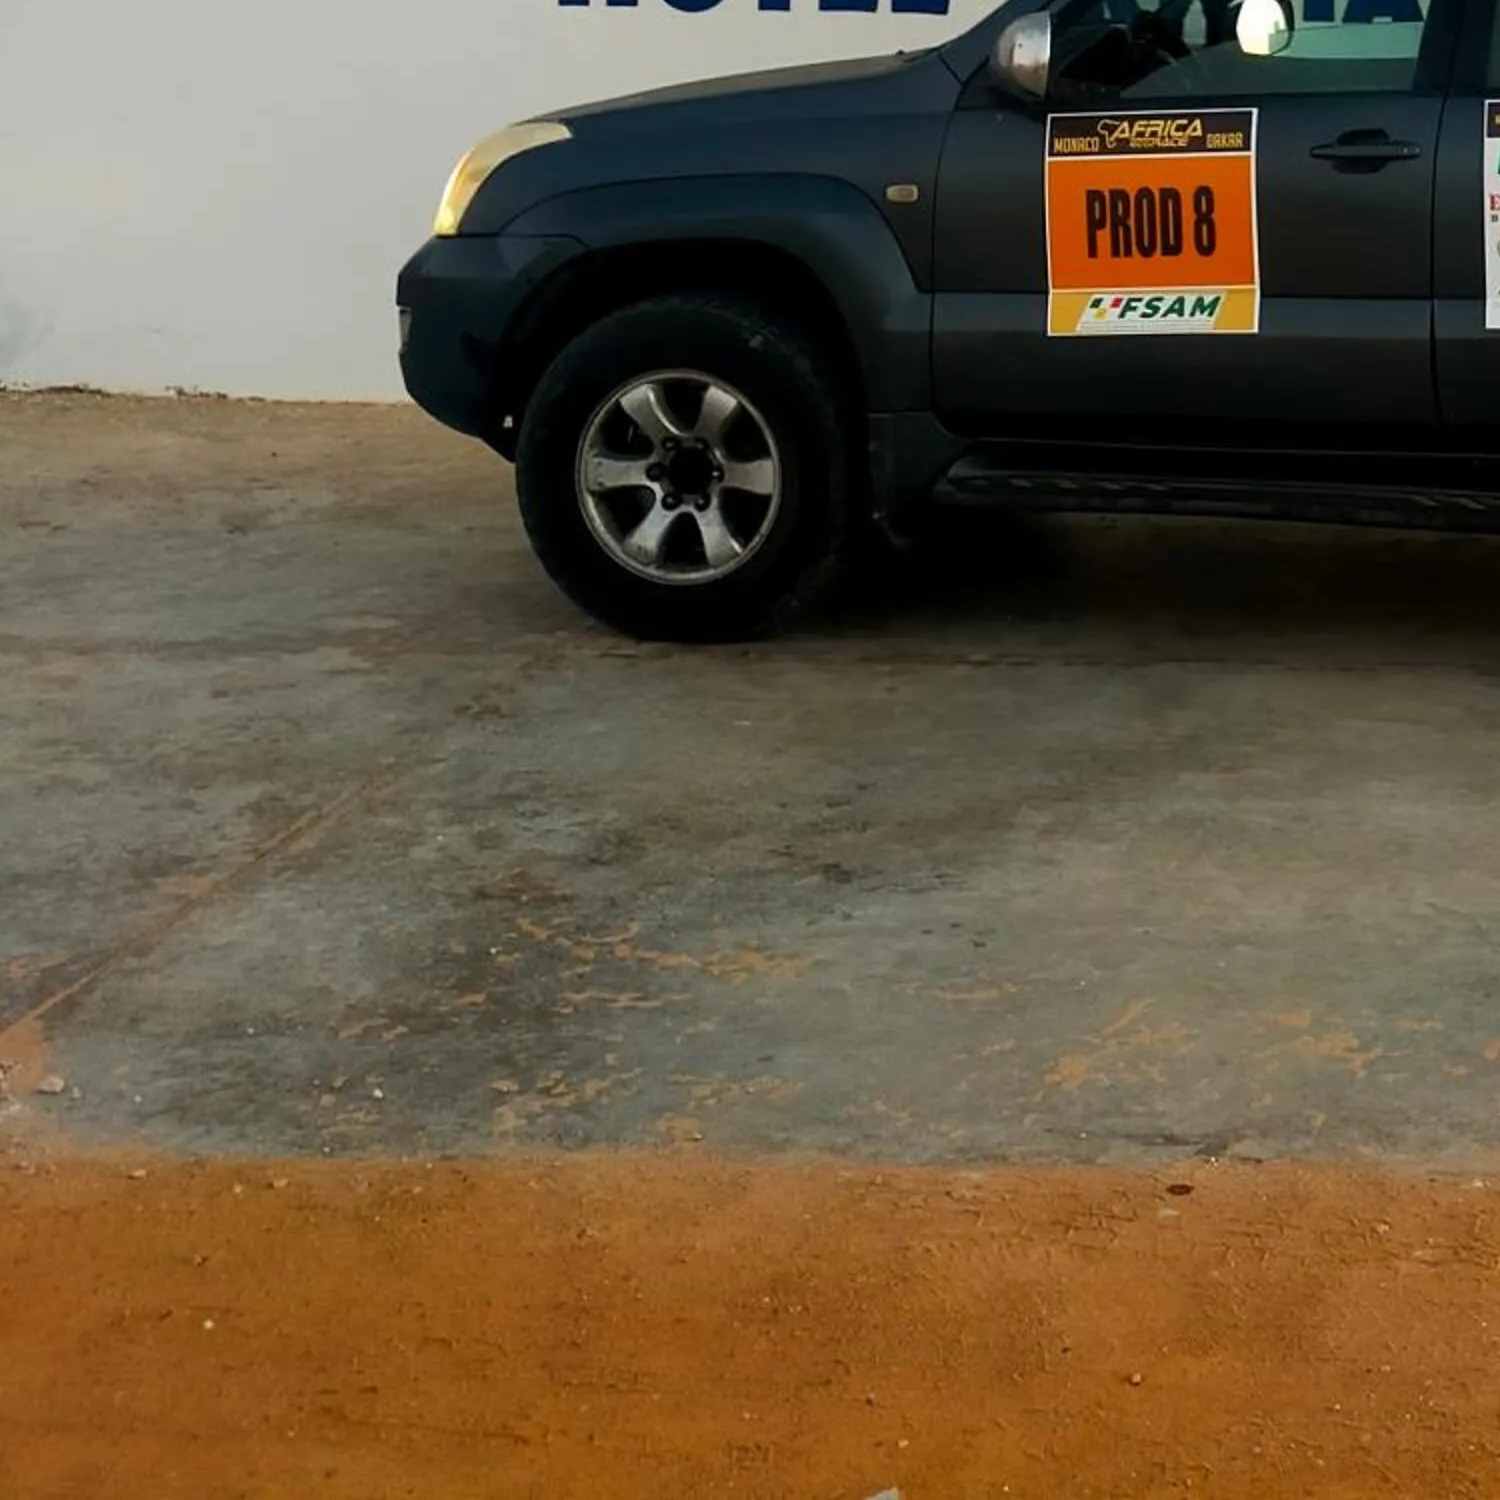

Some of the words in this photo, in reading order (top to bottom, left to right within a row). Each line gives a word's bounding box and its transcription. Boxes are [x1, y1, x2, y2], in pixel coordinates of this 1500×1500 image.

[1053, 136, 1100, 153] MONACO
[1110, 118, 1203, 142] AFRICA
[1206, 132, 1244, 148] DAKAR
[1085, 187, 1184, 258] PROD
[1193, 185, 1217, 257] 8
[1117, 296, 1221, 319] FSAM
